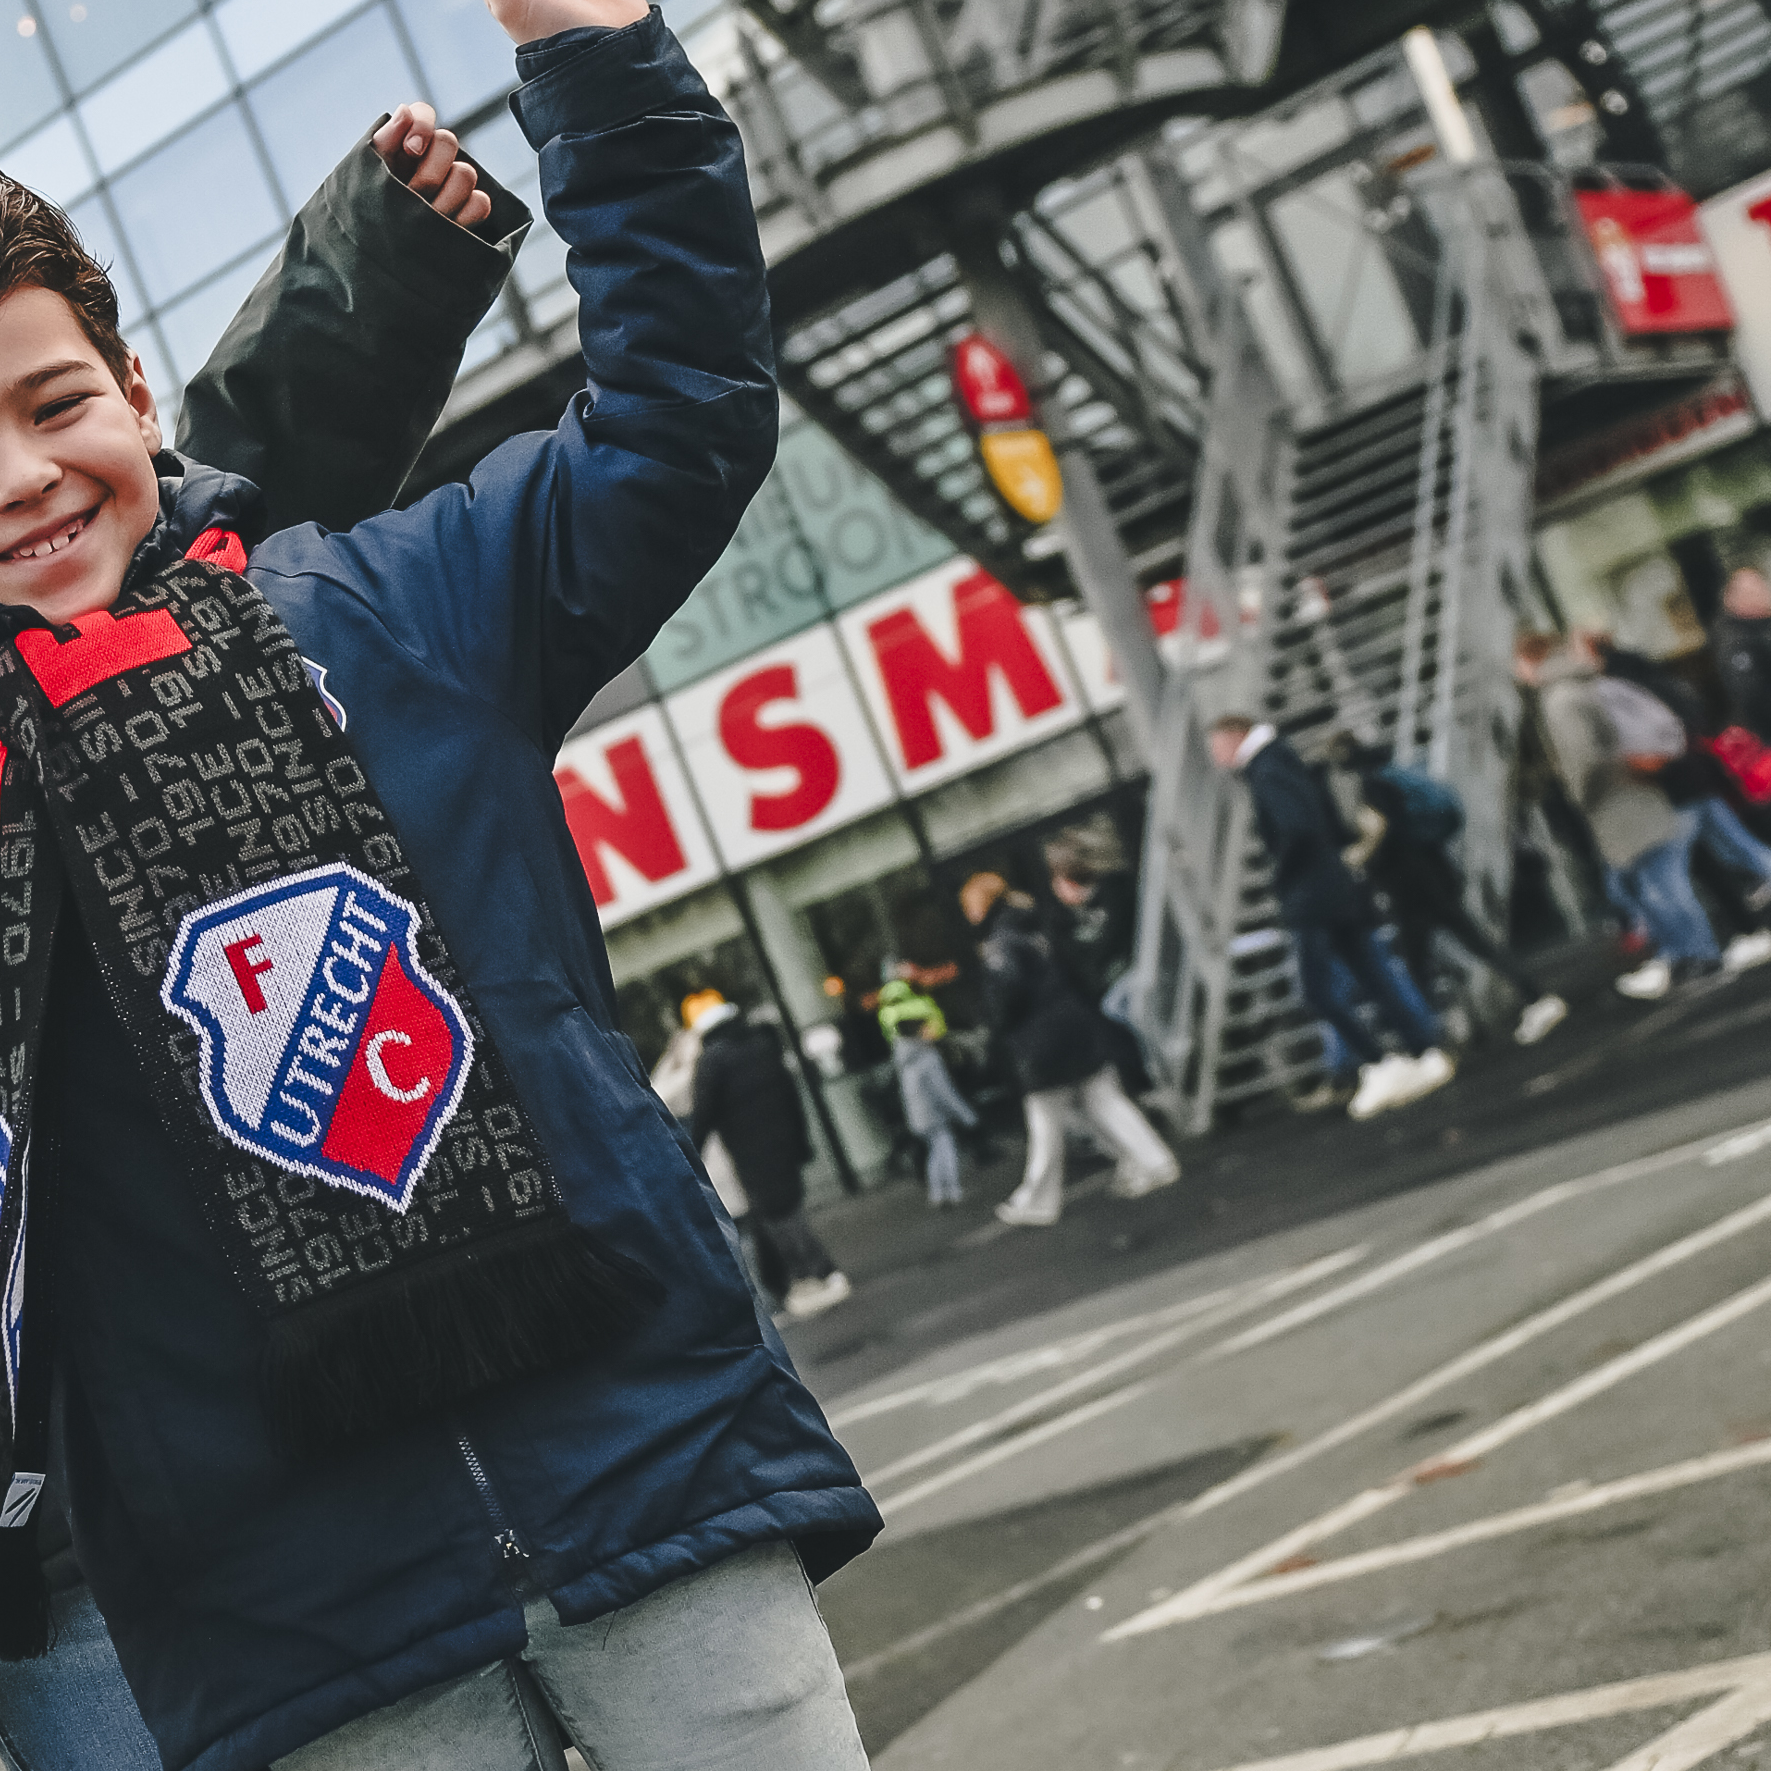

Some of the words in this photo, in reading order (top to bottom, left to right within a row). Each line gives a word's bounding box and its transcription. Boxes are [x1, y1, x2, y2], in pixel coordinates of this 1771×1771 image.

[149, 669, 203, 728] 19
[234, 666, 341, 835] SINCE
[553, 563, 1065, 908] NSM
[125, 709, 213, 846] 1970
[190, 742, 280, 877] INCE
[236, 737, 318, 872] 1970
[324, 755, 410, 884] 1970
[0, 811, 36, 965] 1970
[76, 811, 170, 976] SINCE
[129, 815, 199, 930] 970
[224, 933, 274, 1016] F
[270, 891, 387, 1148] UTRECHT
[365, 1029, 430, 1104] C
[225, 1165, 313, 1302] SINCE
